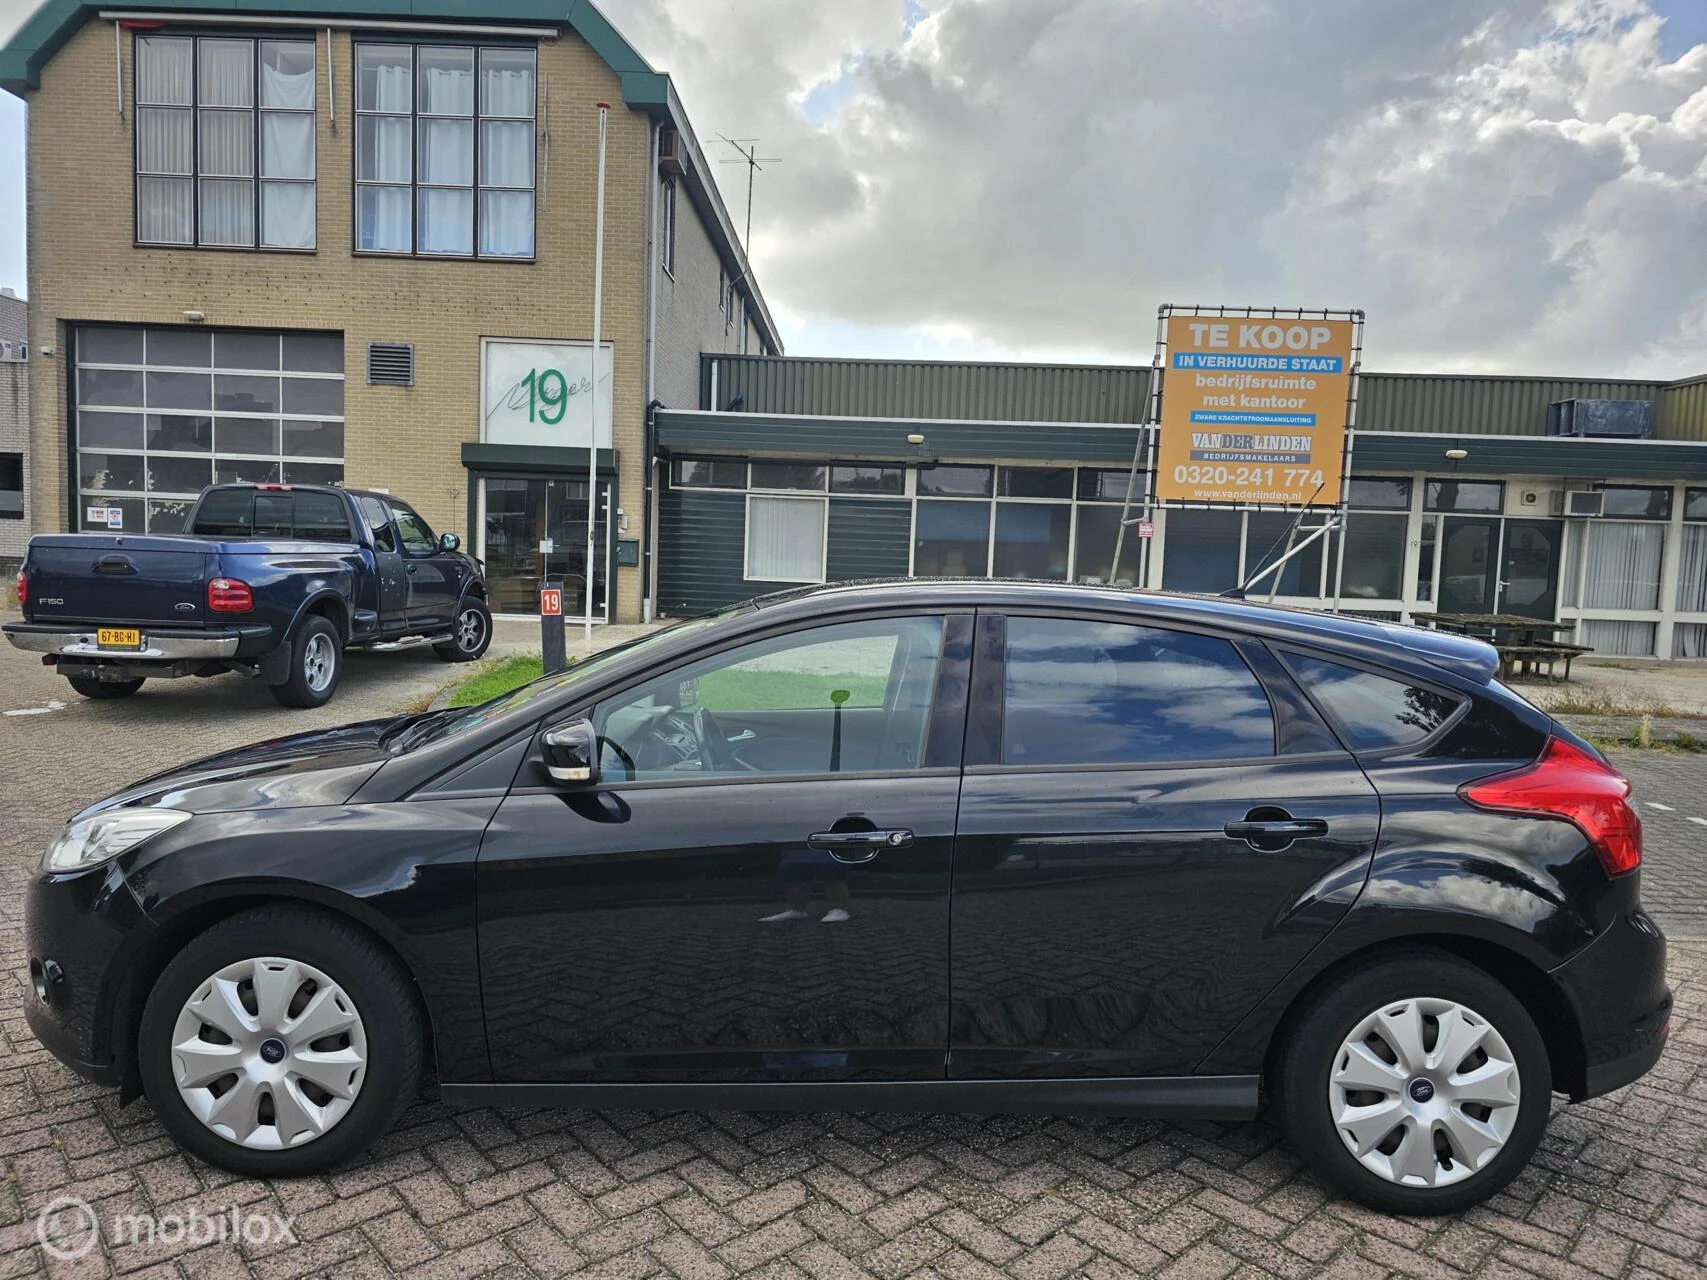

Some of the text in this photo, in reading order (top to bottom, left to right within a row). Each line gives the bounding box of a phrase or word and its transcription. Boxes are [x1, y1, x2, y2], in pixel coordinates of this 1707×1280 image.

[1189, 323, 1331, 350] TE KOOP
[1179, 355, 1336, 371] IN VERHUURDE STAAT
[1195, 374, 1317, 390] bedrijfsruimte
[521, 368, 568, 425] 19
[1203, 394, 1307, 409] met kantoor
[1203, 453, 1296, 462] BEDRIJFSMAKELAARS
[1174, 465, 1325, 487] 0320-241 774
[1194, 489, 1302, 501] www.vanderlinden.nl
[544, 594, 559, 611] 19
